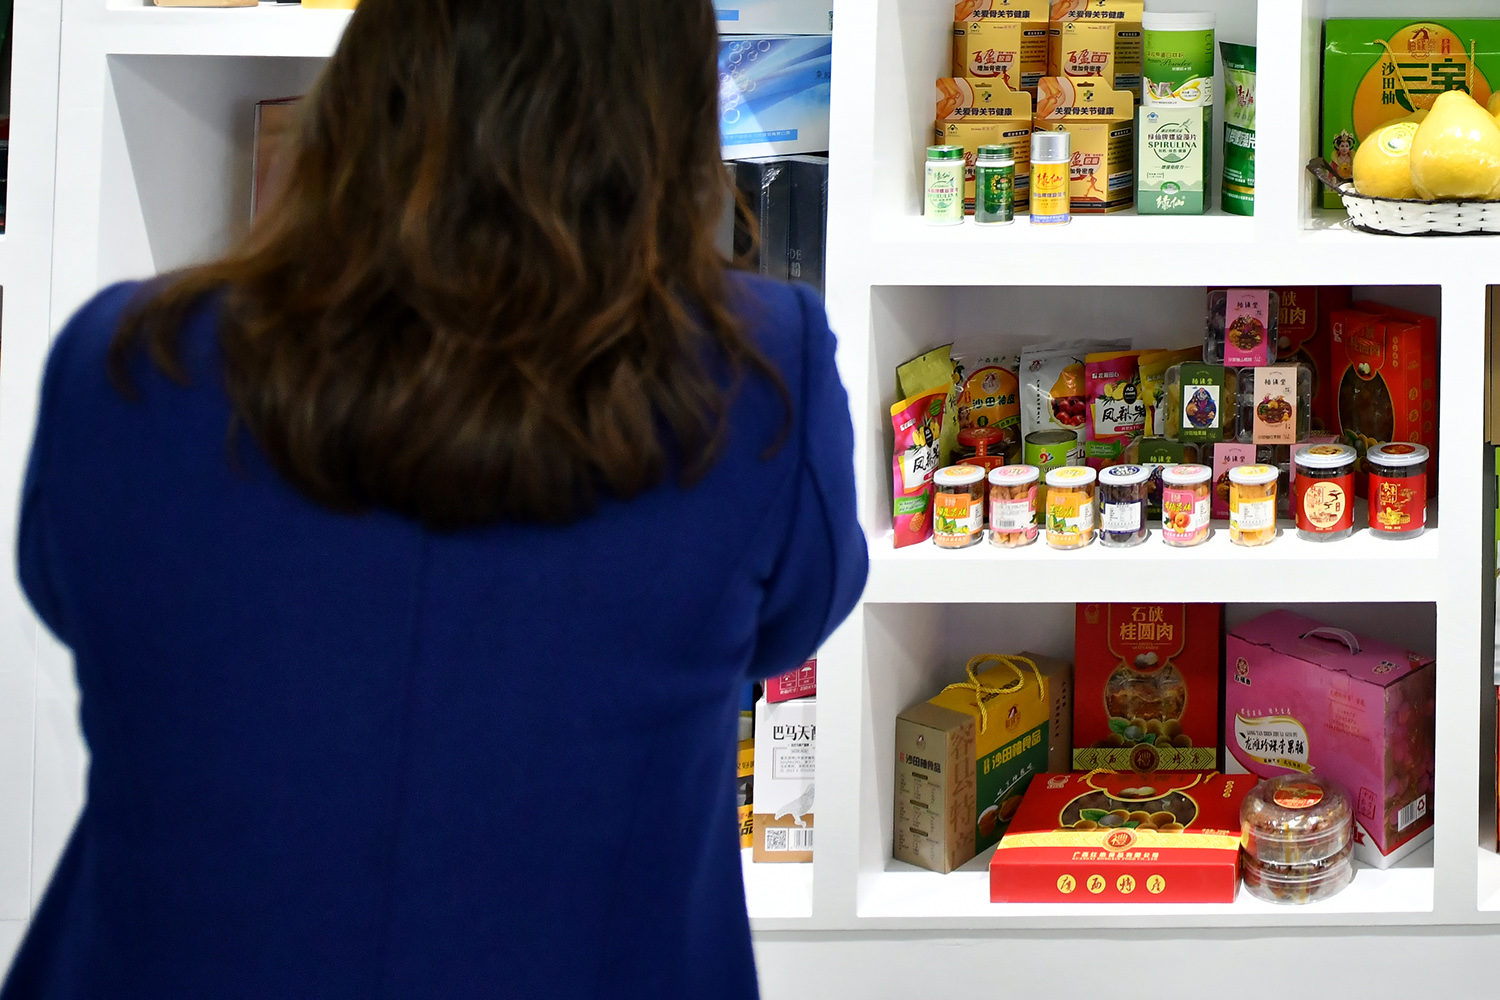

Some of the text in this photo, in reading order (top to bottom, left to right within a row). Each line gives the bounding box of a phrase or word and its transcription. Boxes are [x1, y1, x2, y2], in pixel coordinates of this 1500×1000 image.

[972, 9, 1031, 19] 关爱骨关节健康
[1067, 9, 1125, 19] 关爱骨关节健康
[1381, 61, 1396, 105] 沙田柚
[954, 107, 1013, 117] 关爱骨关节健康
[1054, 107, 1115, 116] 关爱骨关节健康
[1147, 141, 1198, 149] SPIRULINA
[1131, 606, 1165, 623] 石硖
[1119, 622, 1174, 642] 桂圆肉
[991, 728, 1042, 770] 沙田柚食品
